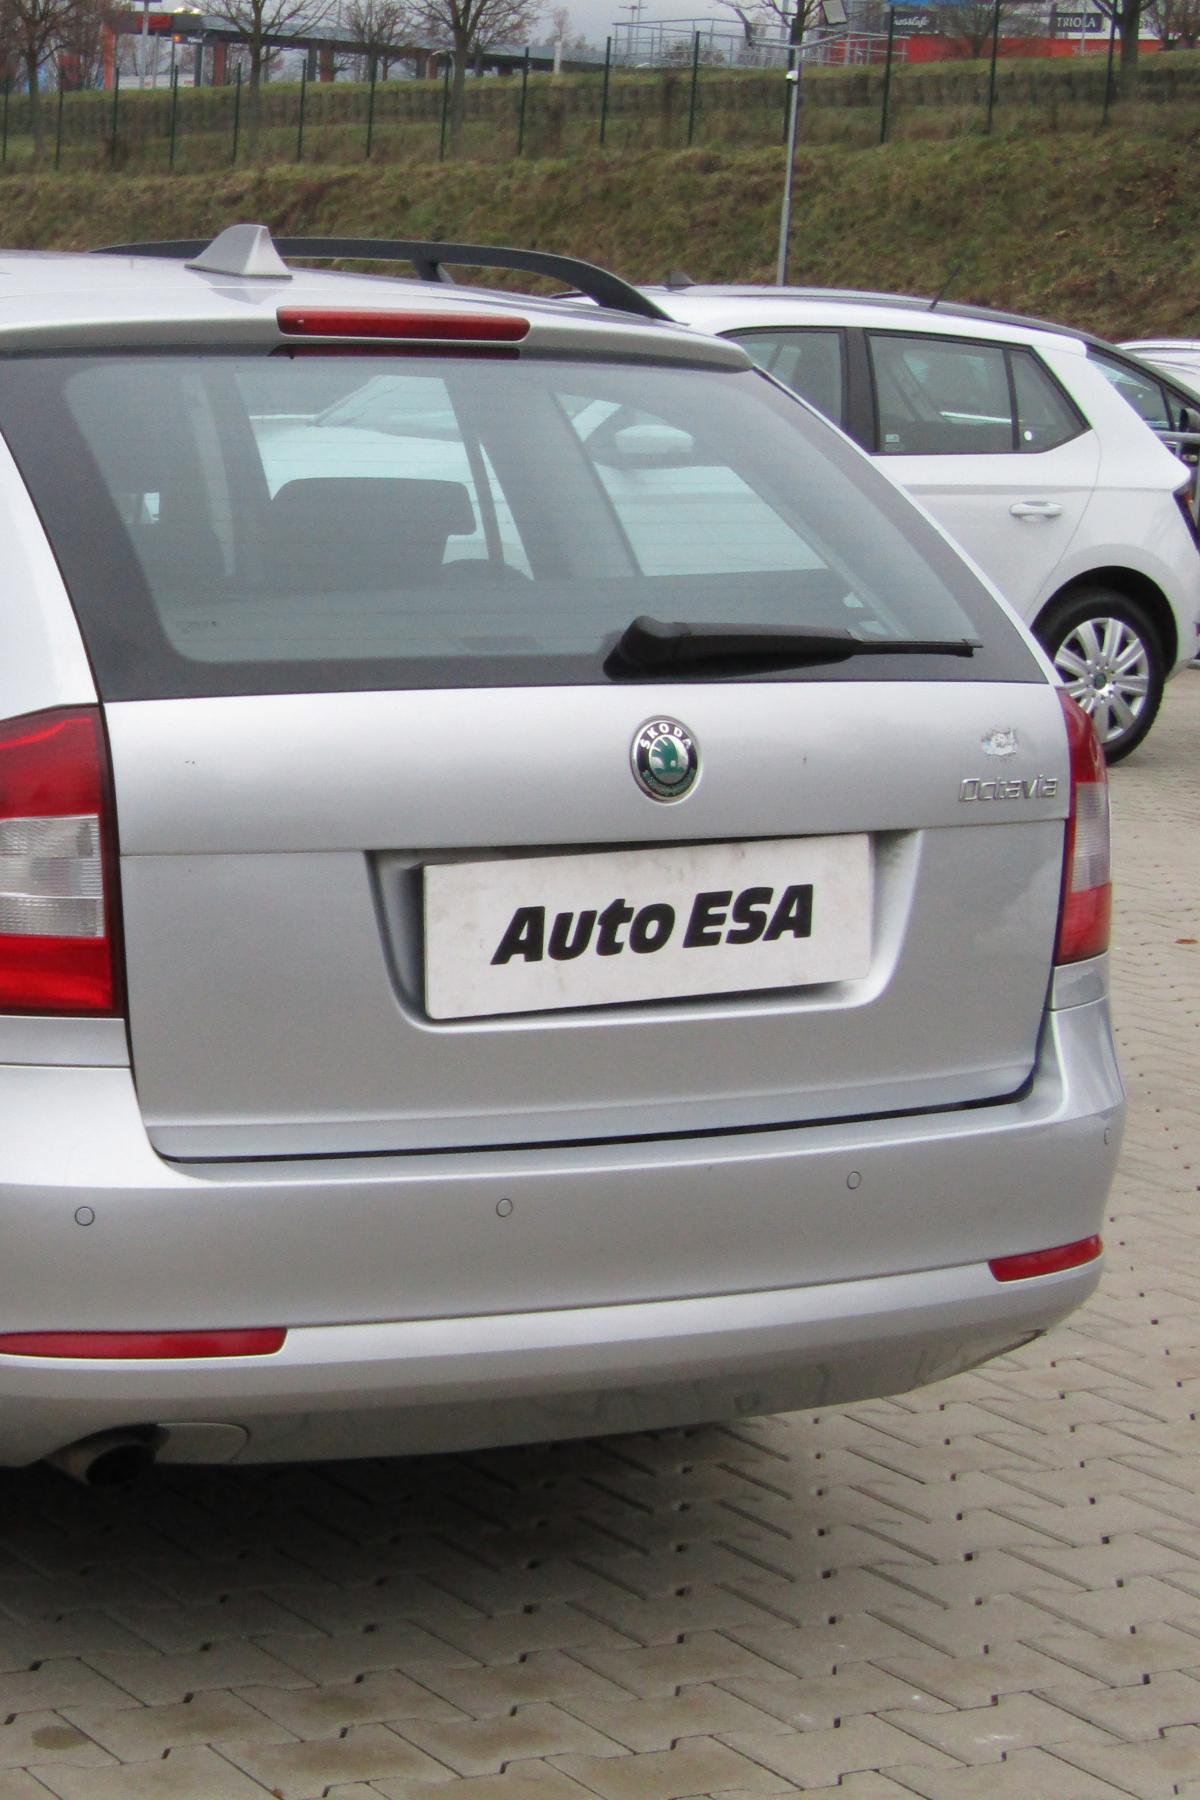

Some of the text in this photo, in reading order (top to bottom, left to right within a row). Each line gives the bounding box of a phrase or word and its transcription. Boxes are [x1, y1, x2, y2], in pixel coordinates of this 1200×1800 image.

[959, 775, 1058, 801] Octavia
[490, 884, 813, 965] Auto ESA
